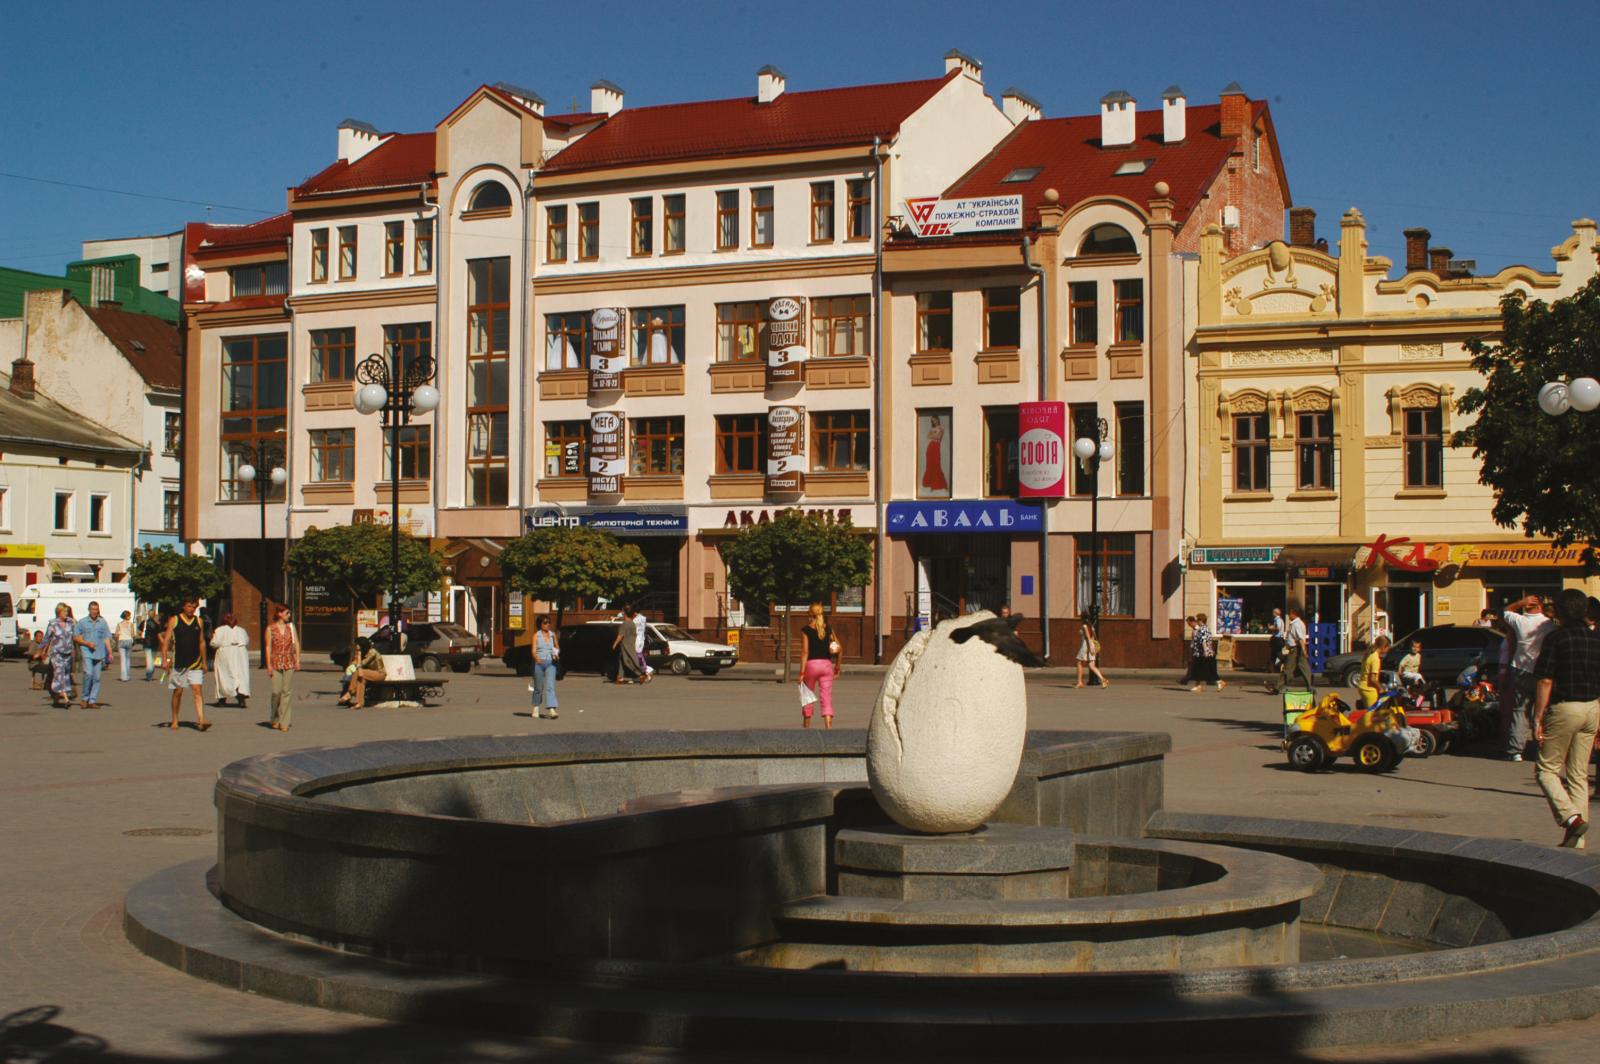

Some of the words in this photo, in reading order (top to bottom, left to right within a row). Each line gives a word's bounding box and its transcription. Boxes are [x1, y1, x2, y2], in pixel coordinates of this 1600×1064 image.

[956, 202, 967, 210] АТ
[935, 208, 1019, 220] ПОЖЕЖНО-СТРАХОВА
[771, 332, 798, 346] ОДЯГ
[777, 350, 789, 363] 3
[598, 358, 609, 370] 3
[594, 416, 615, 429] МЕГА
[1021, 440, 1058, 465] СОФІЯ
[598, 461, 609, 473] 2
[777, 461, 787, 471] 2
[532, 516, 580, 530] ЦЕНТР
[910, 508, 1015, 527] АВАЛЬ
[1019, 514, 1039, 522] БАНК
